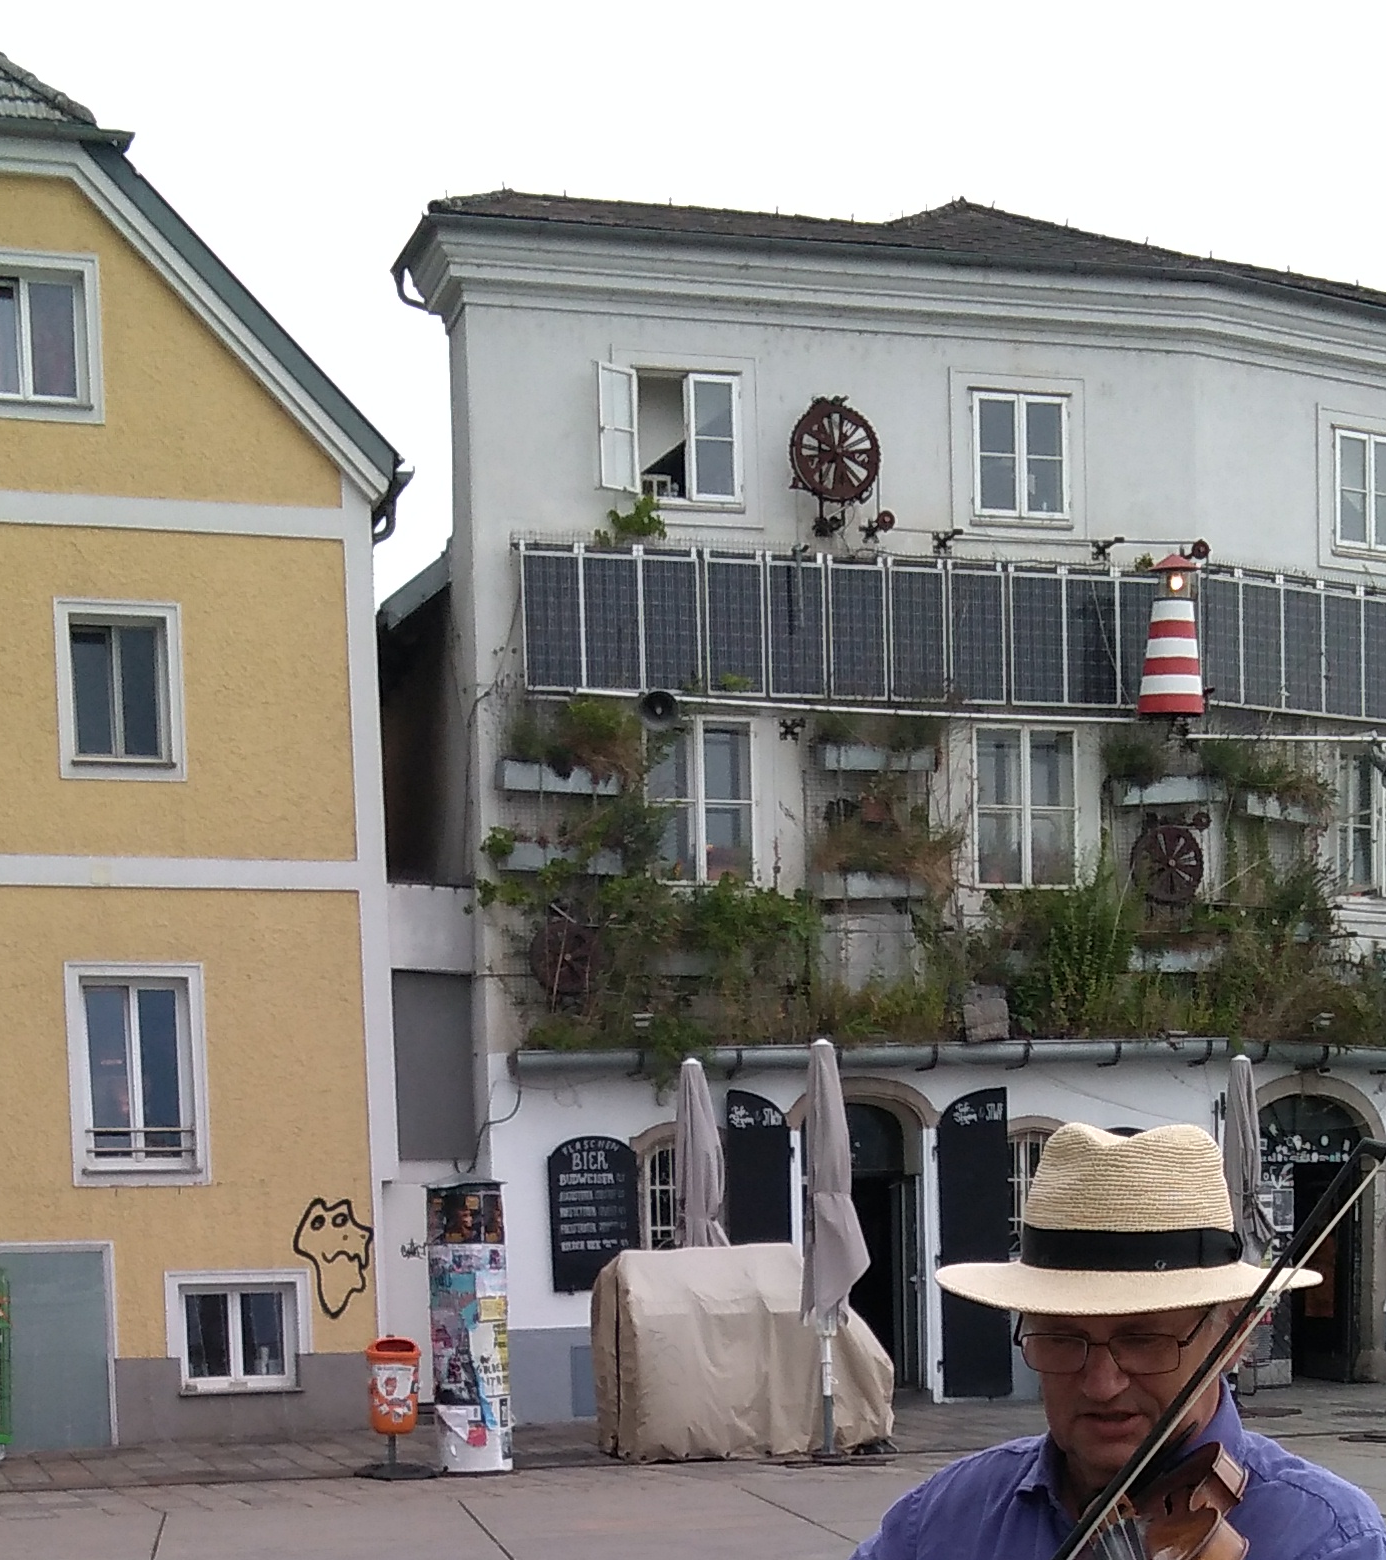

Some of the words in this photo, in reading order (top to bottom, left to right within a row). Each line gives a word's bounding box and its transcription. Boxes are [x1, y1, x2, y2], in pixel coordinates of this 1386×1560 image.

[562, 1139, 620, 1155] FLASCHEN
[572, 1151, 608, 1171] BIER
[559, 1173, 615, 1186] BUDWEISER
